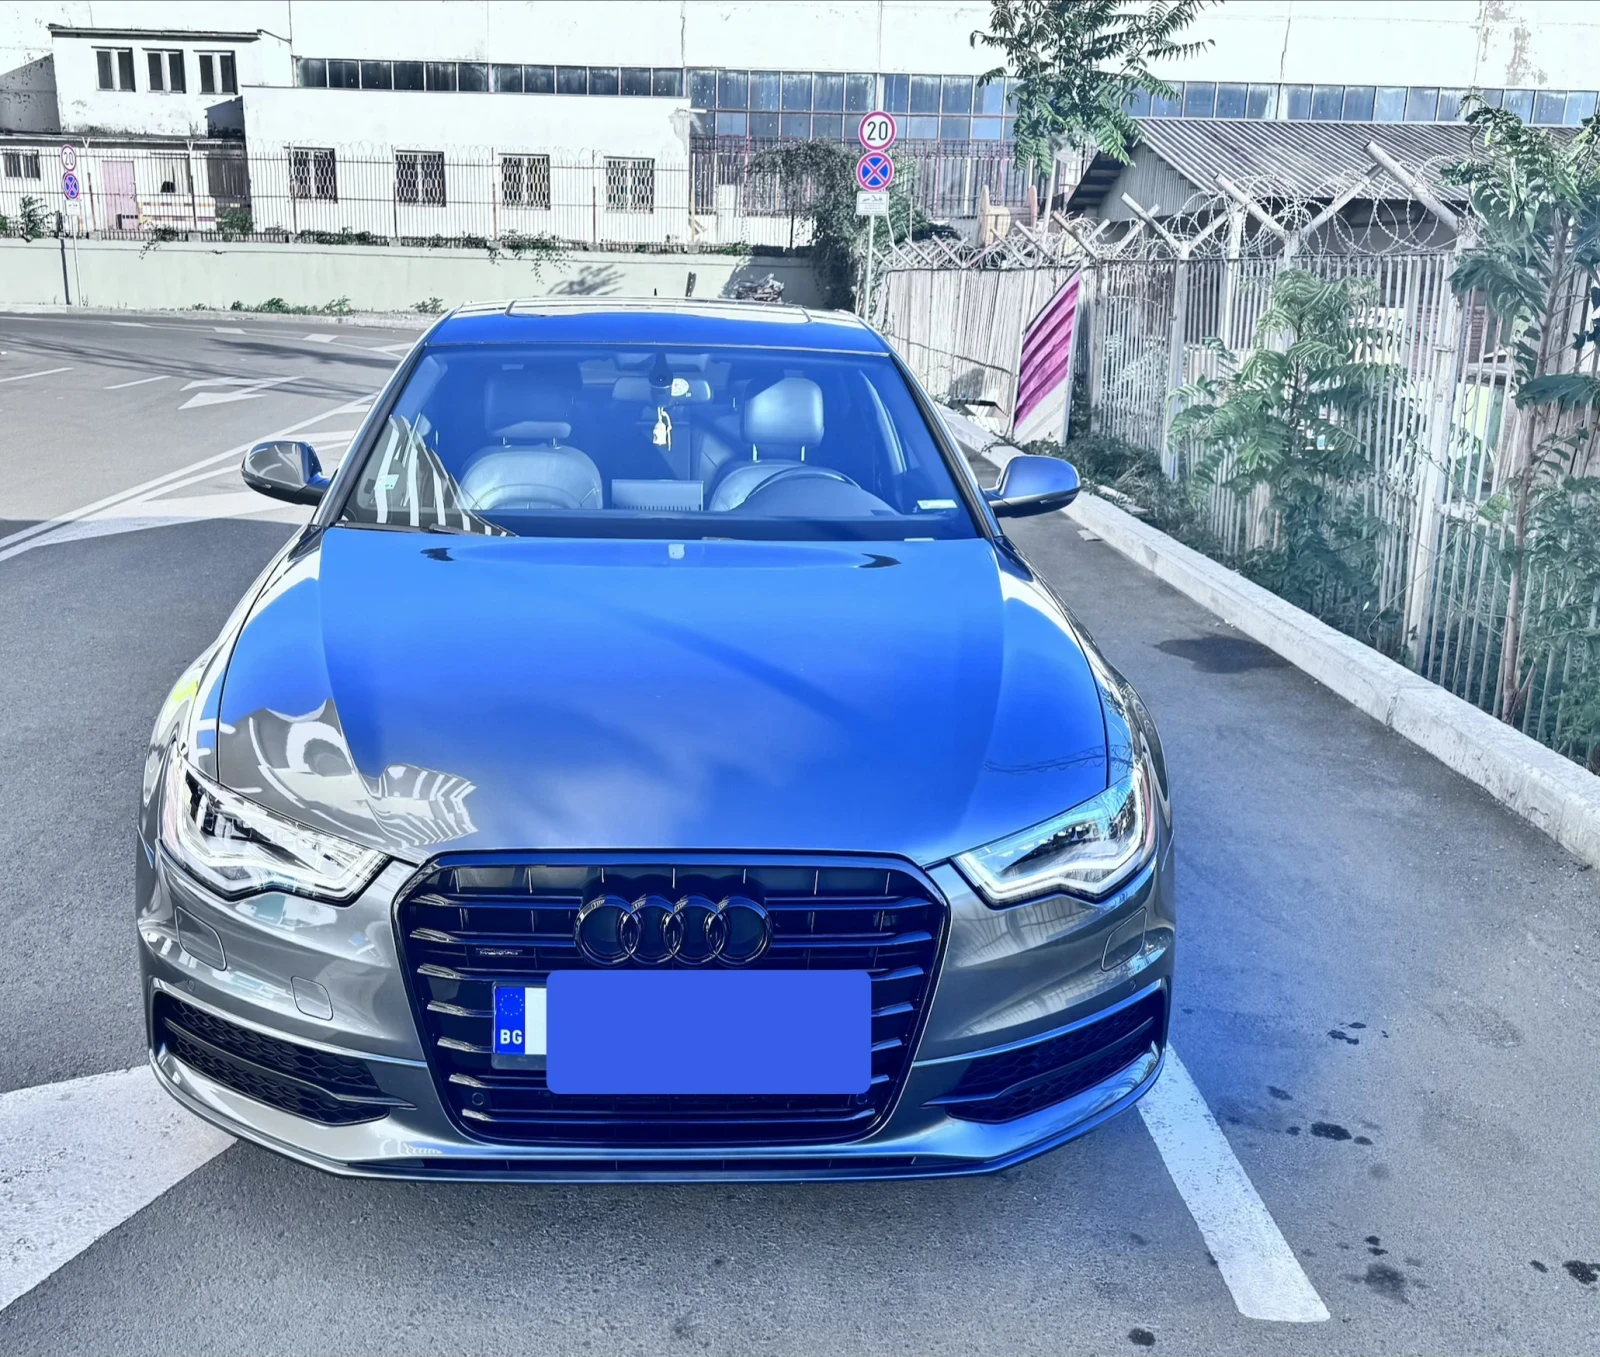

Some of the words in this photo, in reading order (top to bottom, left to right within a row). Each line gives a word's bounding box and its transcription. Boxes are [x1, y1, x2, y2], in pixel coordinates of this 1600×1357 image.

[867, 121, 888, 141] 20
[64, 151, 74, 166] 20
[500, 1029, 523, 1045] BG
